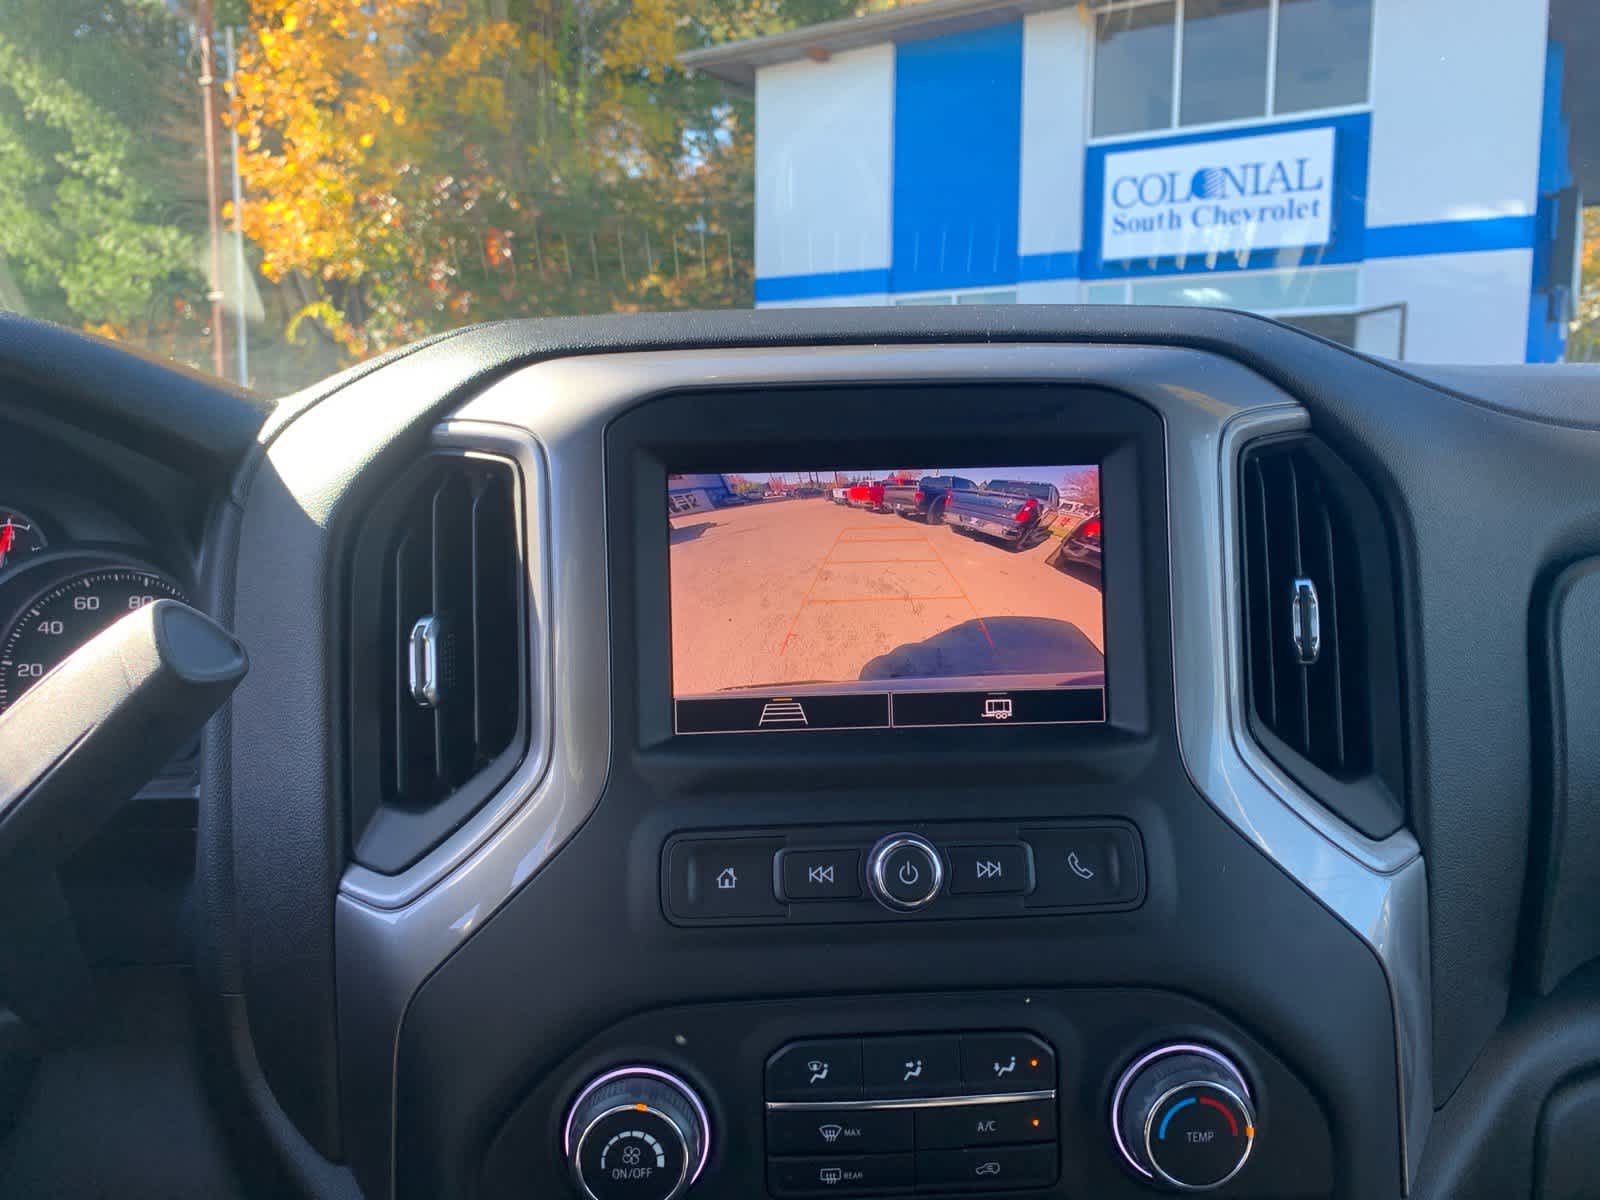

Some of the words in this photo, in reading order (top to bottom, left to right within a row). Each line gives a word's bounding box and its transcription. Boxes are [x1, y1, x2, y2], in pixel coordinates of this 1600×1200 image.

[1112, 157, 1323, 209] COLONIAL
[1112, 207, 1181, 234] South
[1191, 197, 1320, 228] Chevrolet
[74, 596, 100, 610] 60
[37, 620, 64, 635] 40
[17, 663, 43, 677] 20
[843, 1128, 862, 1137] MAX
[976, 1120, 998, 1132] A/C
[1186, 1131, 1215, 1143] TEMP
[611, 1167, 653, 1180] ON/OFF
